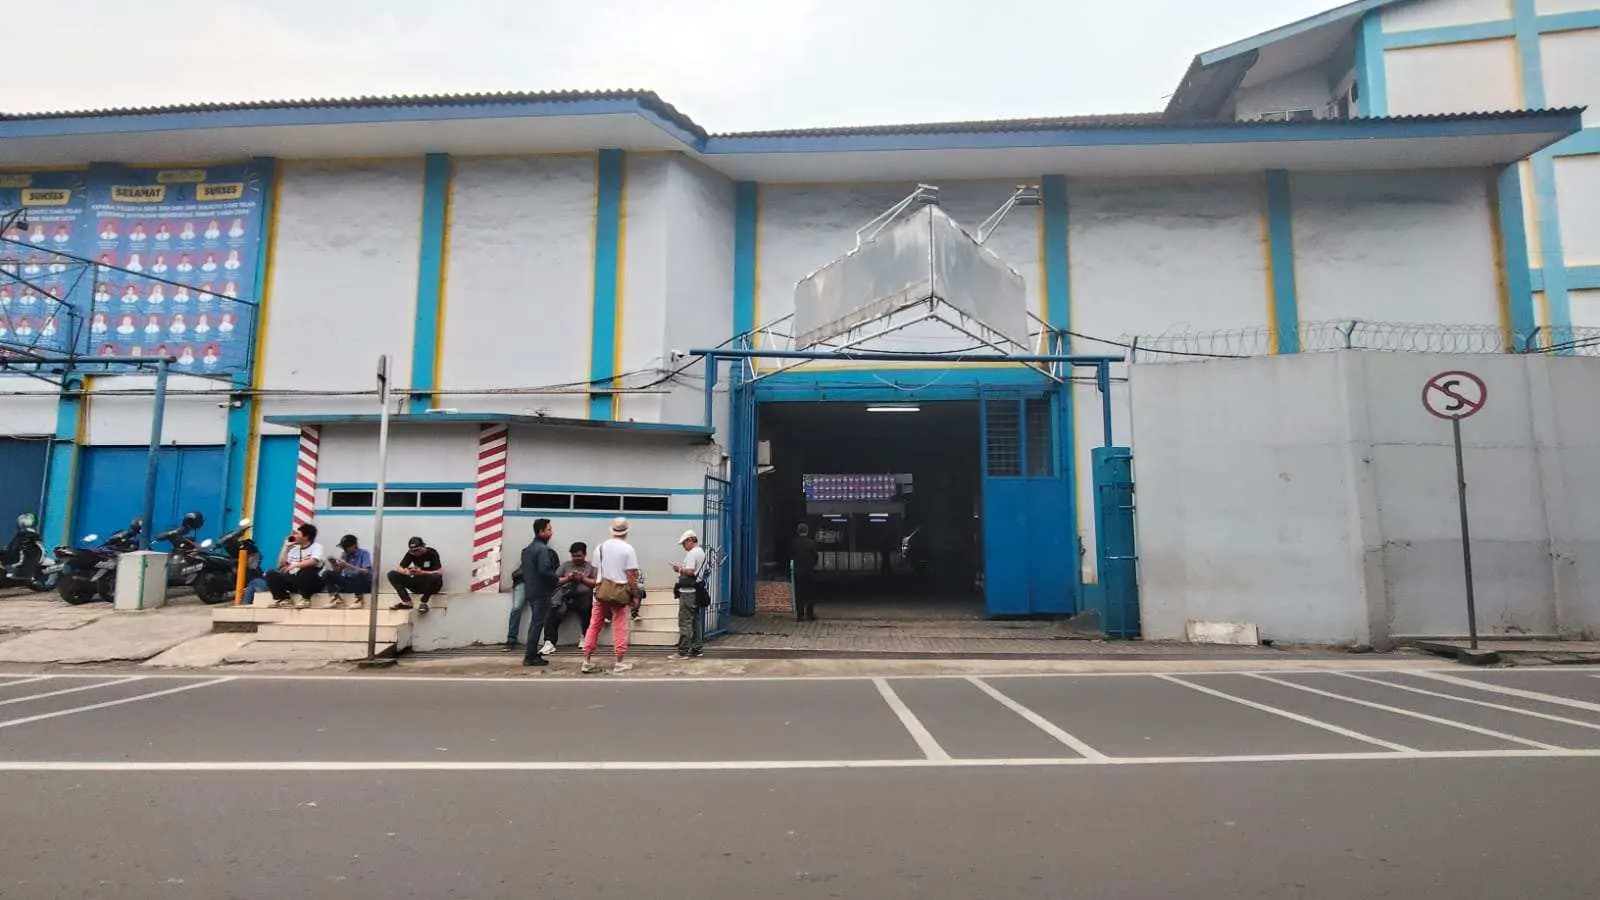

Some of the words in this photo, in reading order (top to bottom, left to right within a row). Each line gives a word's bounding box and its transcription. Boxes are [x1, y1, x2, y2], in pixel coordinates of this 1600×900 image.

[29, 191, 65, 201] SUKSES
[115, 187, 162, 198] SELAMAT
[204, 185, 238, 196] SUKSES
[1442, 380, 1465, 411] S
